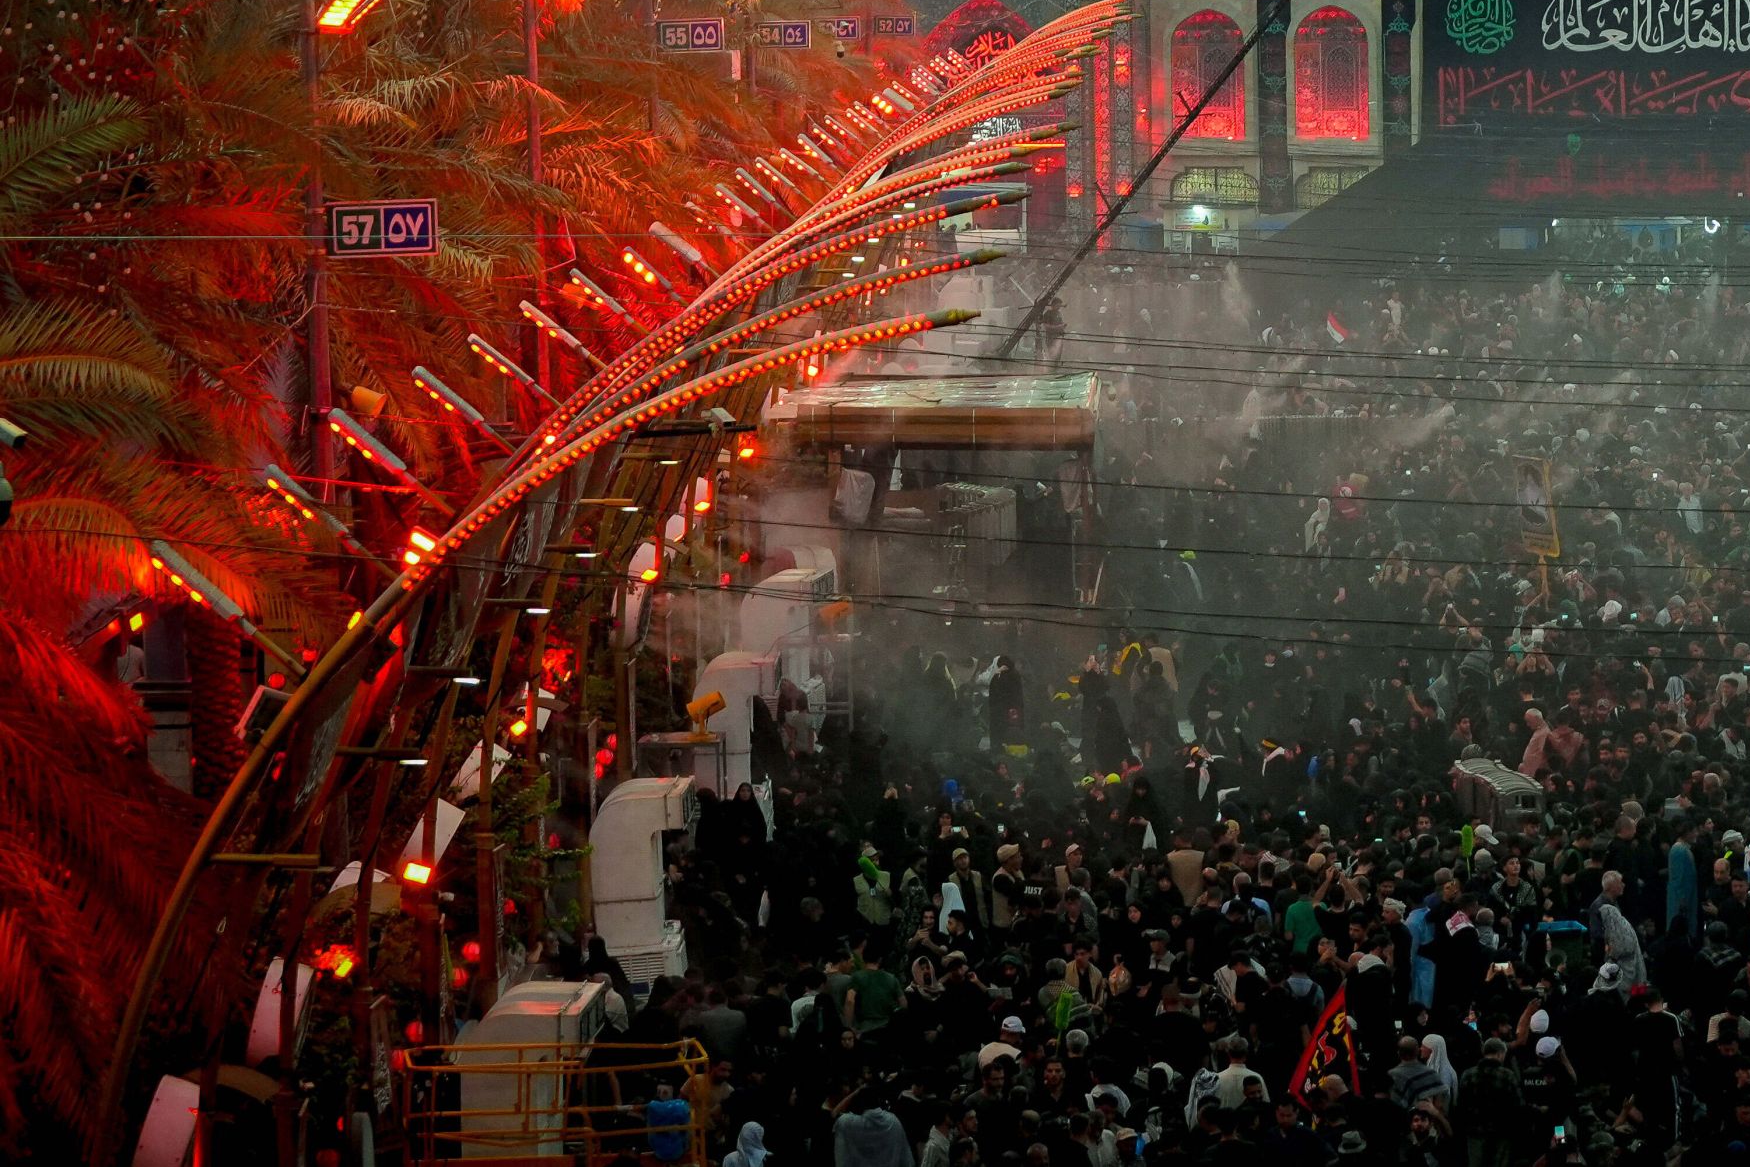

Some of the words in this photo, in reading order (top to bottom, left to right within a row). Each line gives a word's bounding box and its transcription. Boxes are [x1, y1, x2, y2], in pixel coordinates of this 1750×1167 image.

[879, 20, 893, 32] 52
[665, 27, 687, 46] 55
[342, 215, 374, 245] 57
[388, 212, 424, 244] ٥٧
[1023, 885, 1043, 896] JUST
